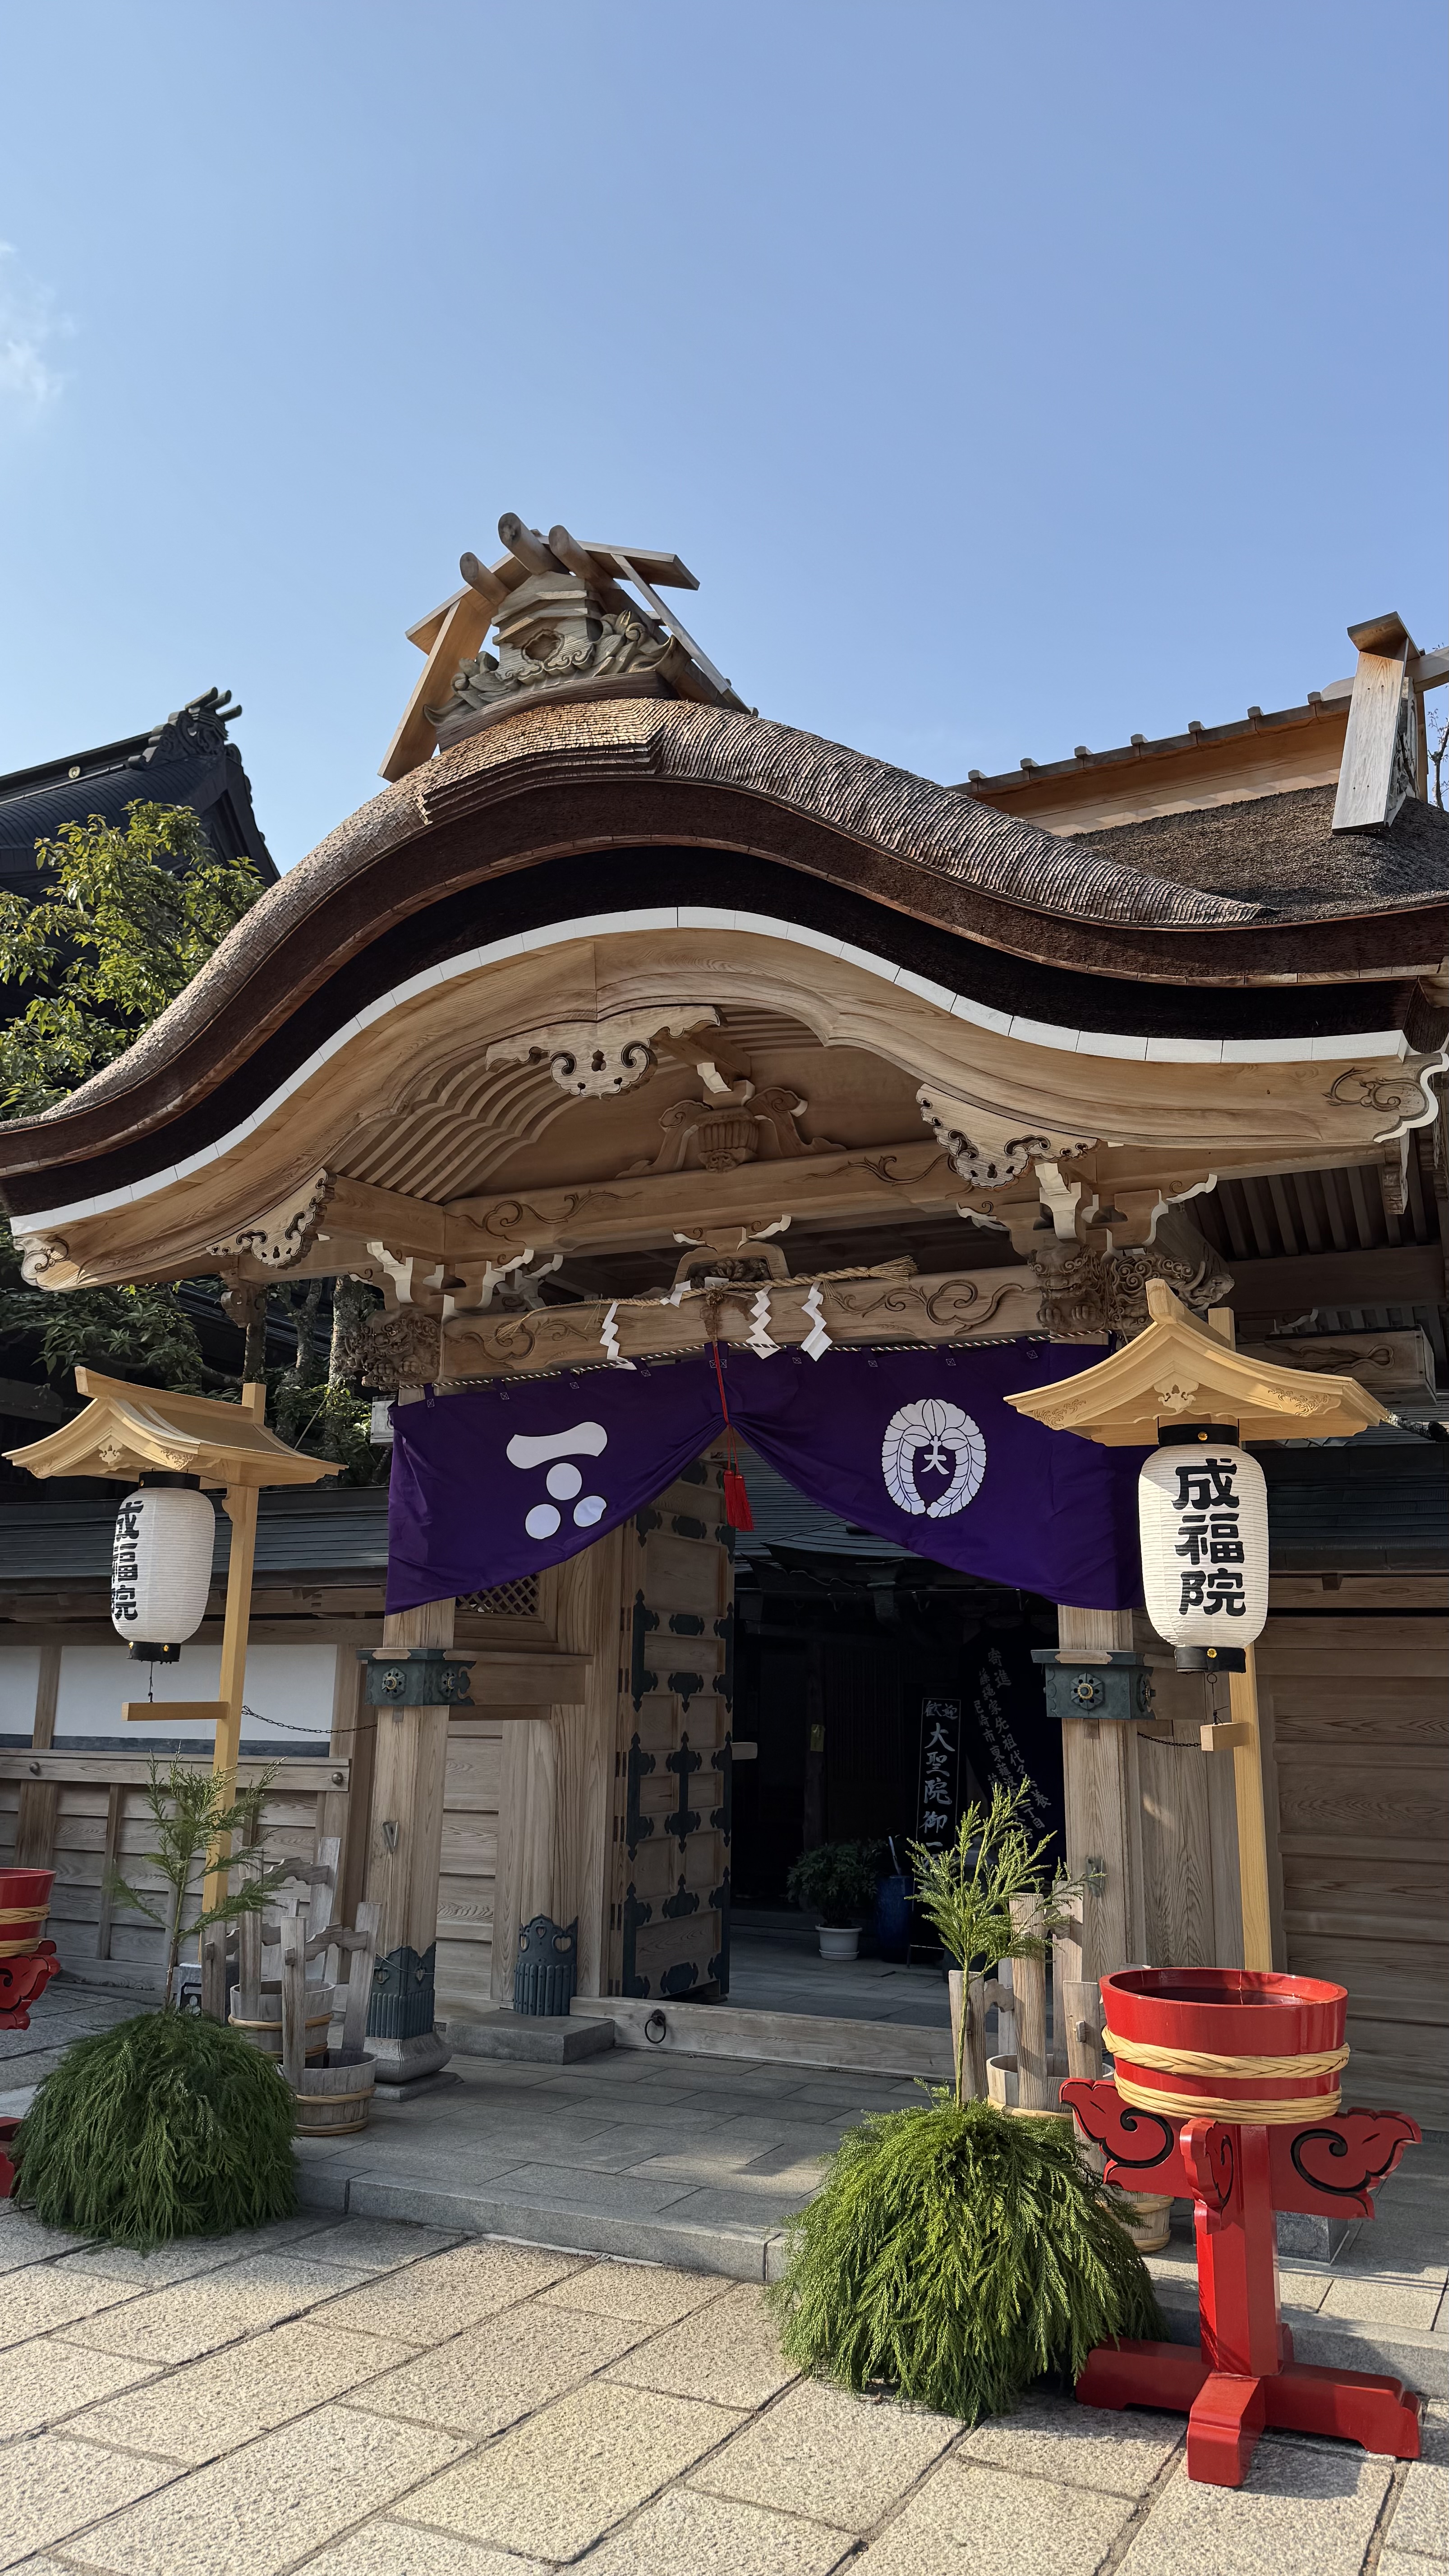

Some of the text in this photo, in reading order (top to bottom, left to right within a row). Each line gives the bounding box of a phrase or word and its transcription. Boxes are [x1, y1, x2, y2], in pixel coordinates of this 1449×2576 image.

[110, 1500, 144, 1621] 成福院
[1172, 1458, 1246, 1617] 成福院
[988, 1647, 1012, 1688] 寄進
